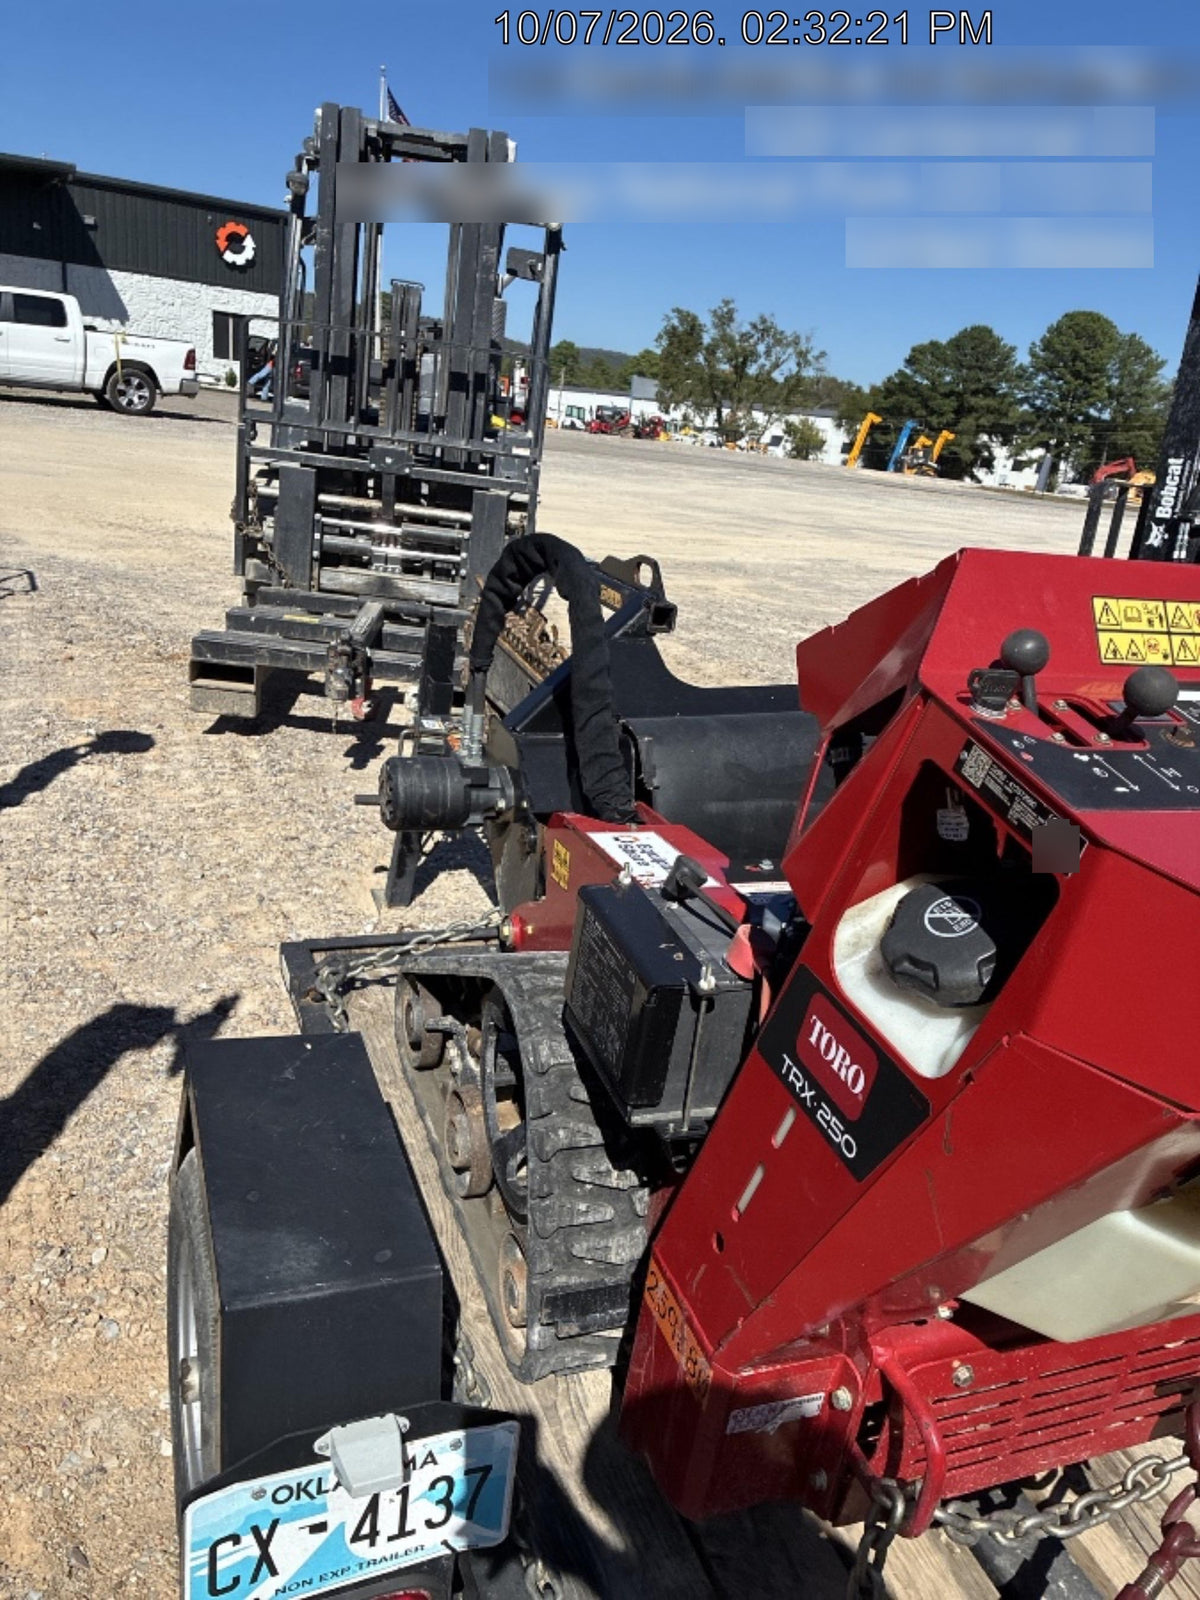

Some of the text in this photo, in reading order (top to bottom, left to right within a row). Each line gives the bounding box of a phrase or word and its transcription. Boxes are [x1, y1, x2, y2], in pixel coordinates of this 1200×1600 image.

[1155, 457, 1185, 519] Bobcat
[808, 1014, 866, 1095] TORO
[349, 1464, 493, 1548] 4137
[274, 1577, 314, 1597] NON
